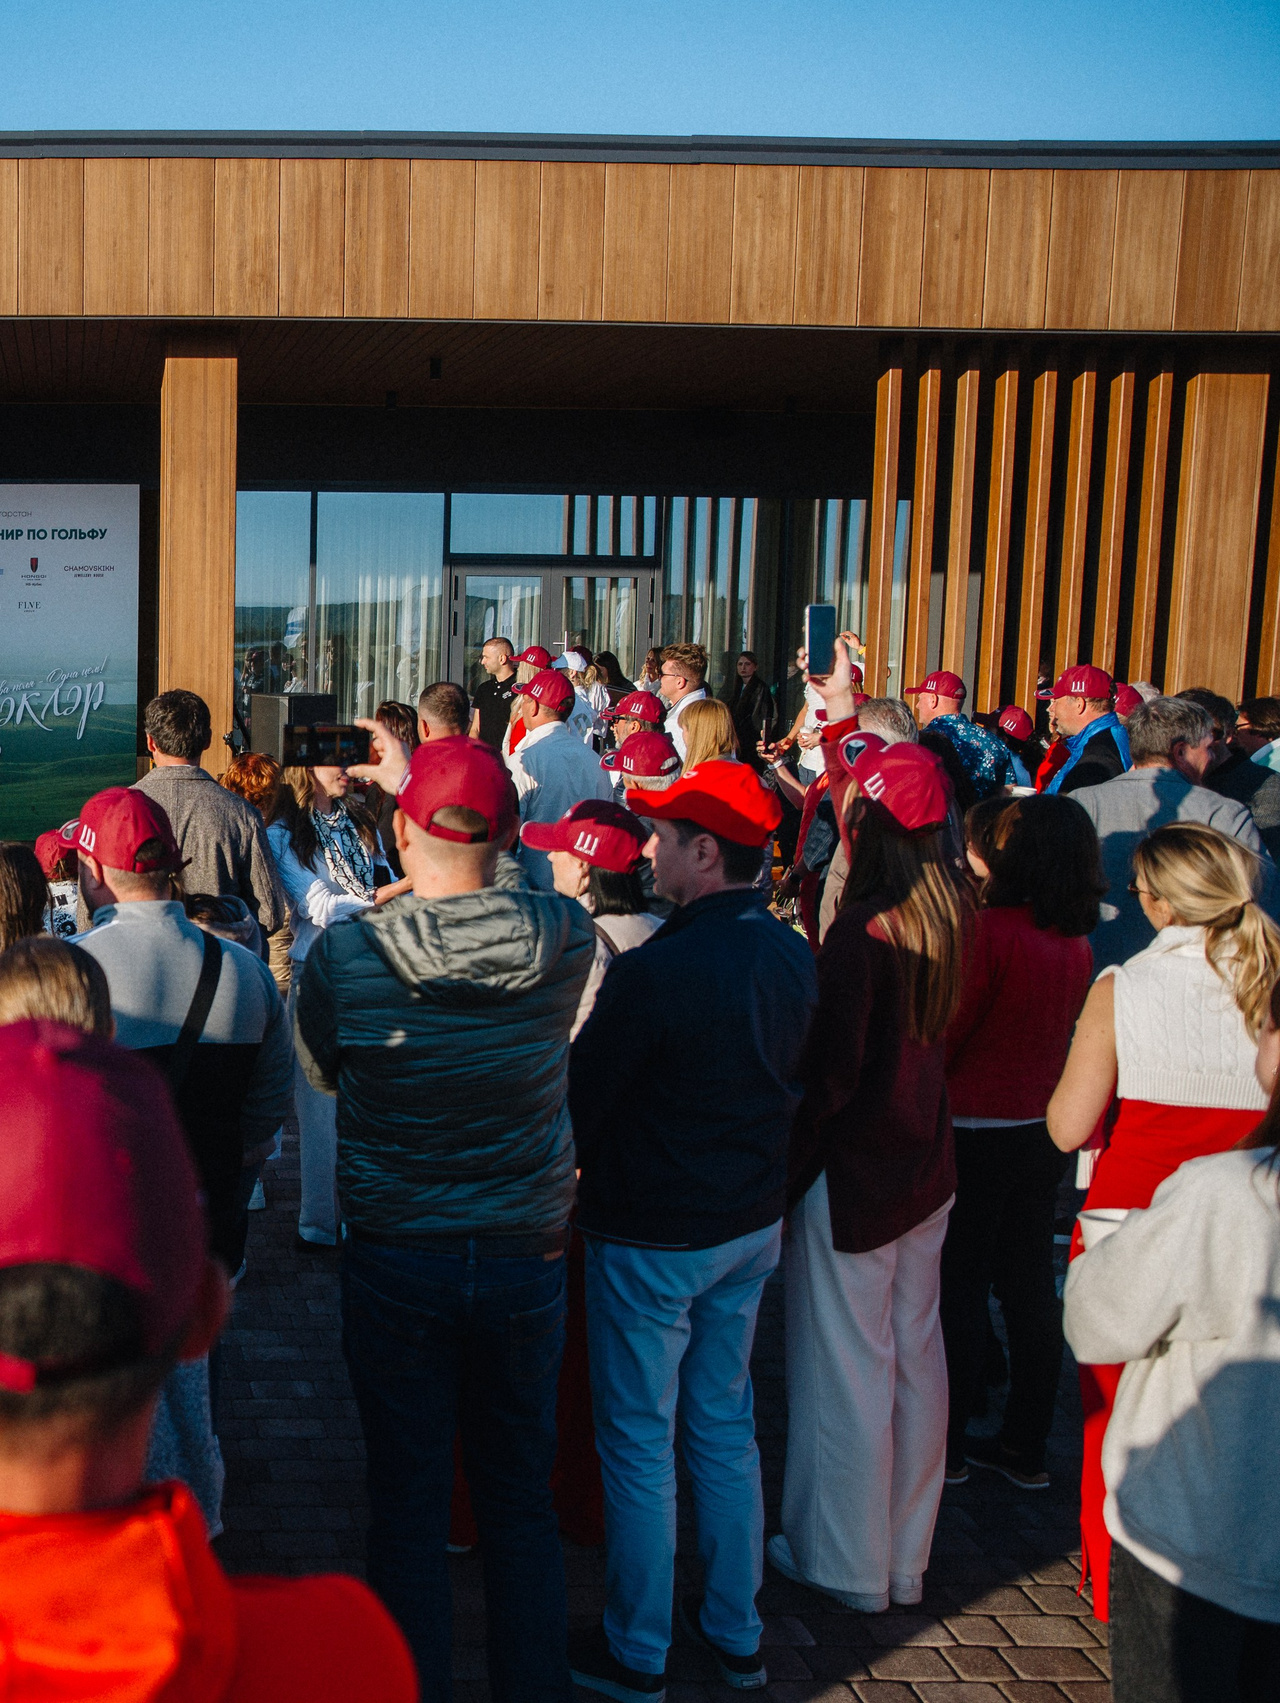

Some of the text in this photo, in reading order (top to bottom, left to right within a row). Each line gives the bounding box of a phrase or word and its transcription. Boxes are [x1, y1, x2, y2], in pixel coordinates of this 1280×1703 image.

[27, 528, 48, 540] ПО
[51, 528, 108, 541] ГОЛЬФУ
[18, 601, 41, 610] FINE
